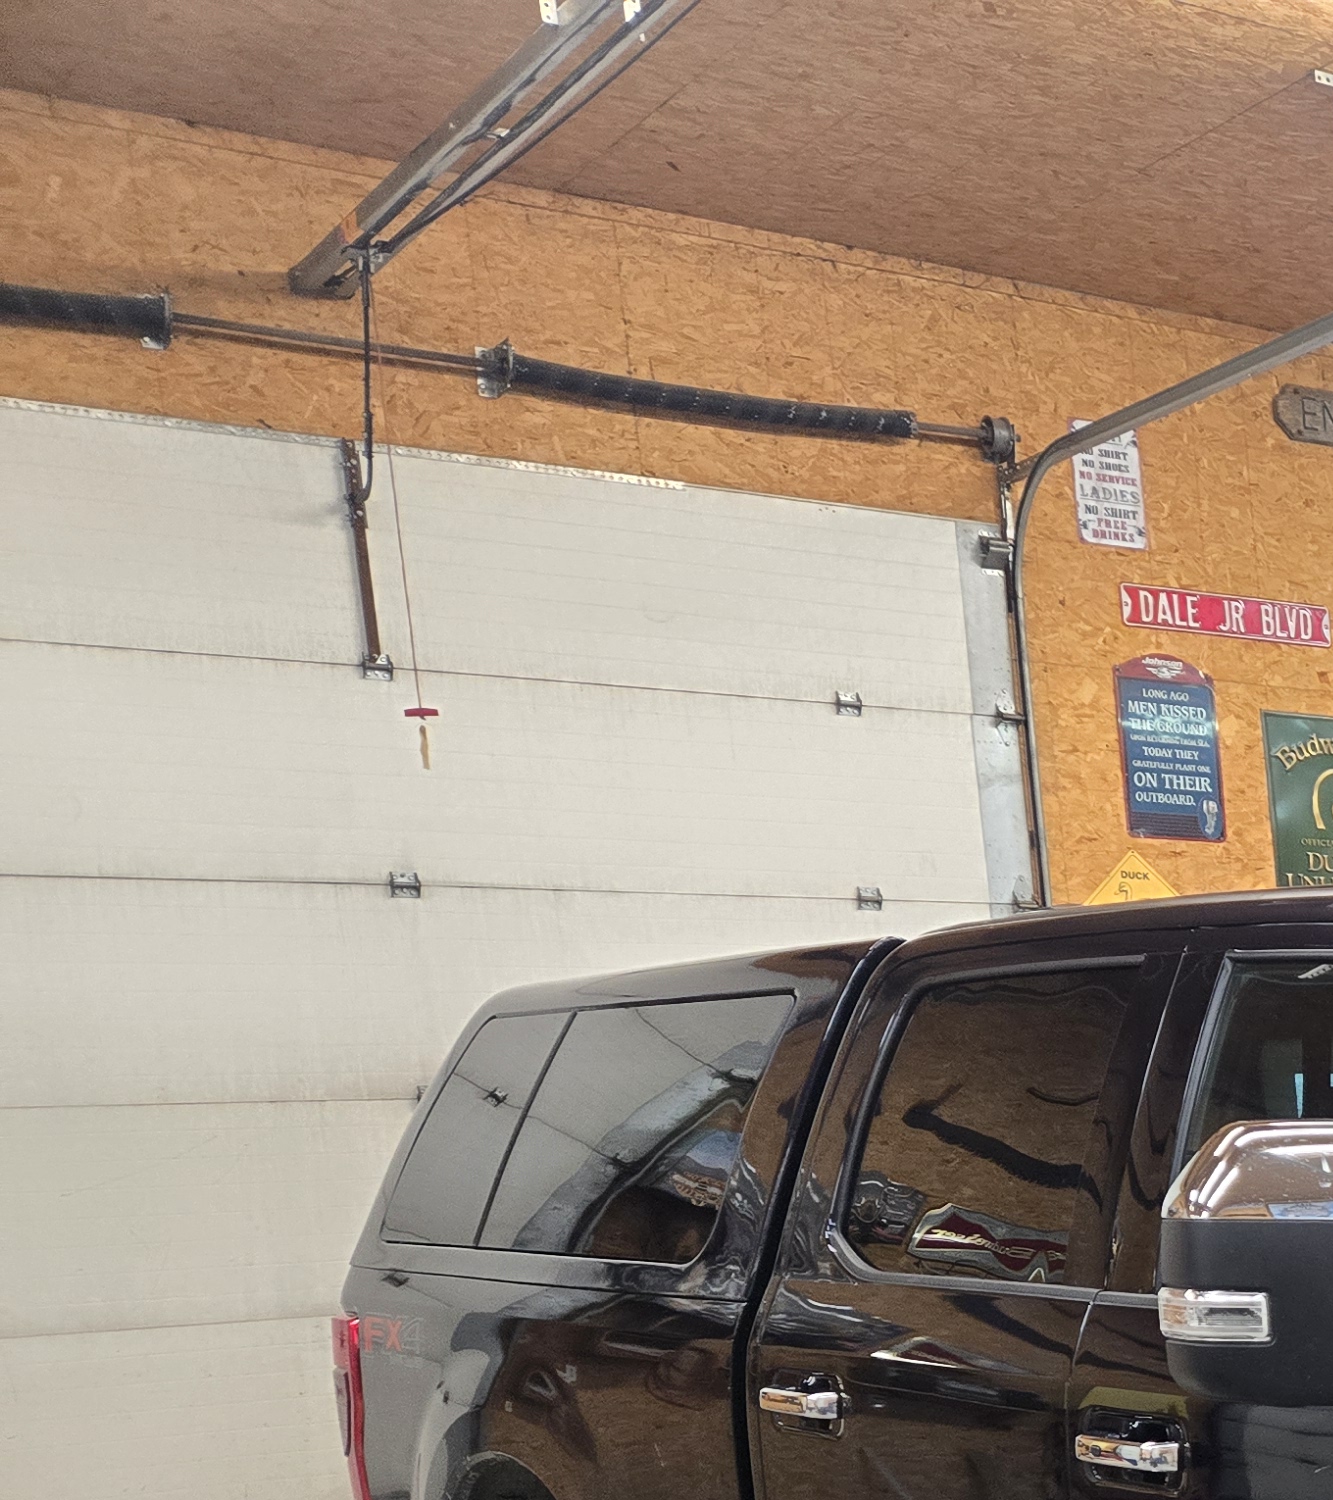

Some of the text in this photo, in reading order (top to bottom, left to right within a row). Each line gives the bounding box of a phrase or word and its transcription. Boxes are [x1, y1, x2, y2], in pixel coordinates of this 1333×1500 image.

[1098, 449, 1128, 461] SHIRT
[1082, 458, 1130, 473] NO SHOES
[1079, 470, 1137, 487] NO SERVICE
[1080, 484, 1140, 504] LADIES
[1084, 504, 1138, 520] NO SHIRT
[1097, 518, 1127, 530] FREE
[1092, 529, 1135, 543] DRINKS
[1138, 589, 1312, 640] DALE JR BLVD
[1141, 656, 1184, 669] Johnson
[1142, 688, 1189, 702] LONG AGO
[1127, 700, 1207, 720] MEN KISSED
[1128, 718, 1208, 736] THE GROUND
[1142, 746, 1199, 760] TODAY THEY
[1134, 772, 1213, 792] ON THEIR
[1120, 870, 1151, 881] DUCK
[362, 1314, 422, 1355] FX4
